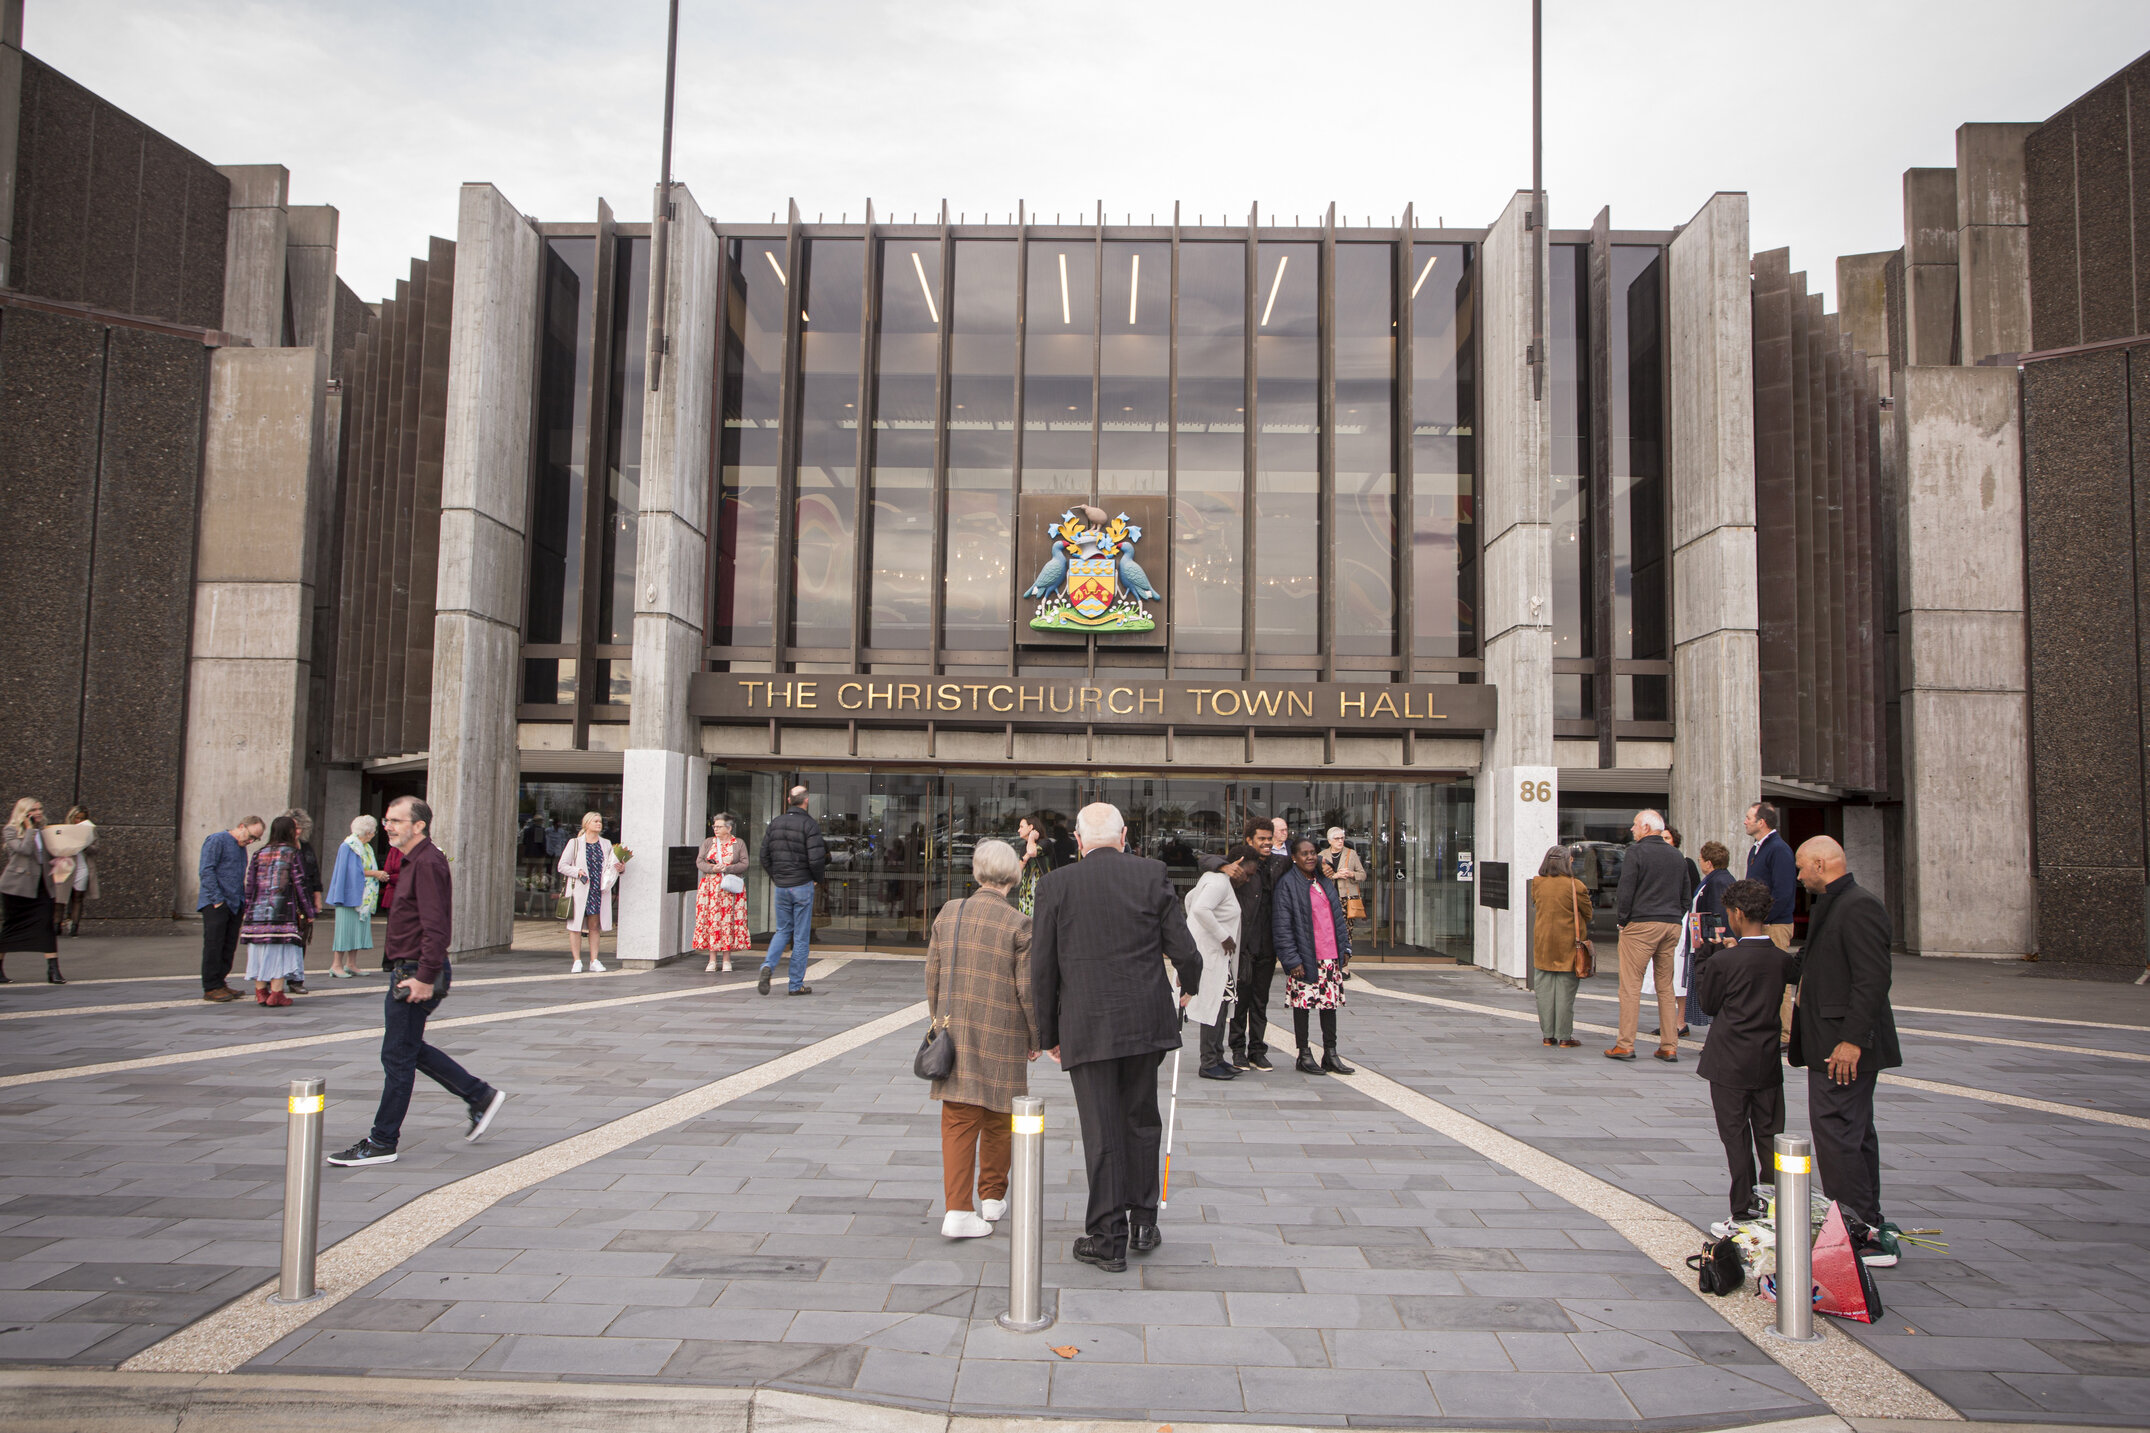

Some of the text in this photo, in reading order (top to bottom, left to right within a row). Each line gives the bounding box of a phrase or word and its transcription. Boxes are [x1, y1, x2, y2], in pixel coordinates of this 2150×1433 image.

[738, 681, 1448, 719] THE CHRISTCHURCH TOWN HALL
[1520, 780, 1552, 803] 86
